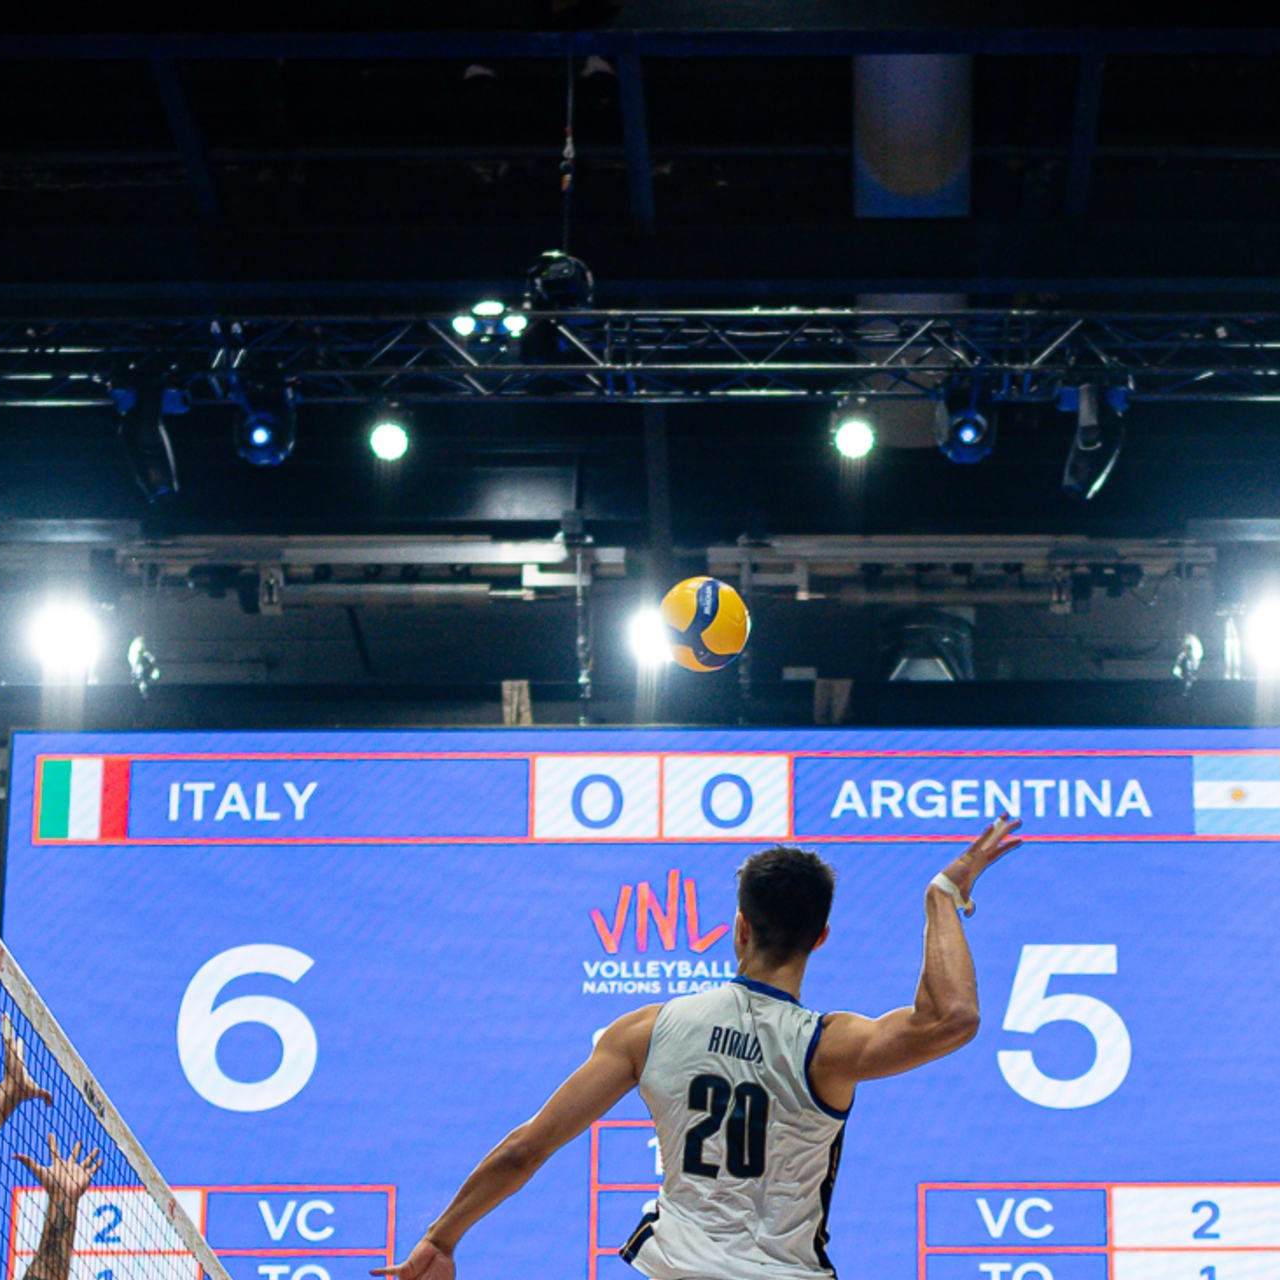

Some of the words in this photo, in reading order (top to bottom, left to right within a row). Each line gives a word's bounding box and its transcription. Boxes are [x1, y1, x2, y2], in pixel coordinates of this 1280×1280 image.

[168, 782, 318, 822] ITALY
[830, 778, 1153, 820] ARGENTINA
[590, 869, 730, 954] VNL
[582, 960, 736, 978] VOLLEYBALL
[582, 981, 662, 995] NATIONS
[667, 981, 729, 995] LEAGU
[176, 943, 318, 1113] 6
[996, 943, 1132, 1110] 5
[682, 1074, 769, 1179] 20
[93, 1203, 122, 1244] 2
[257, 1199, 336, 1242] VC
[976, 1197, 1054, 1239] VC
[1190, 1200, 1222, 1241] 2
